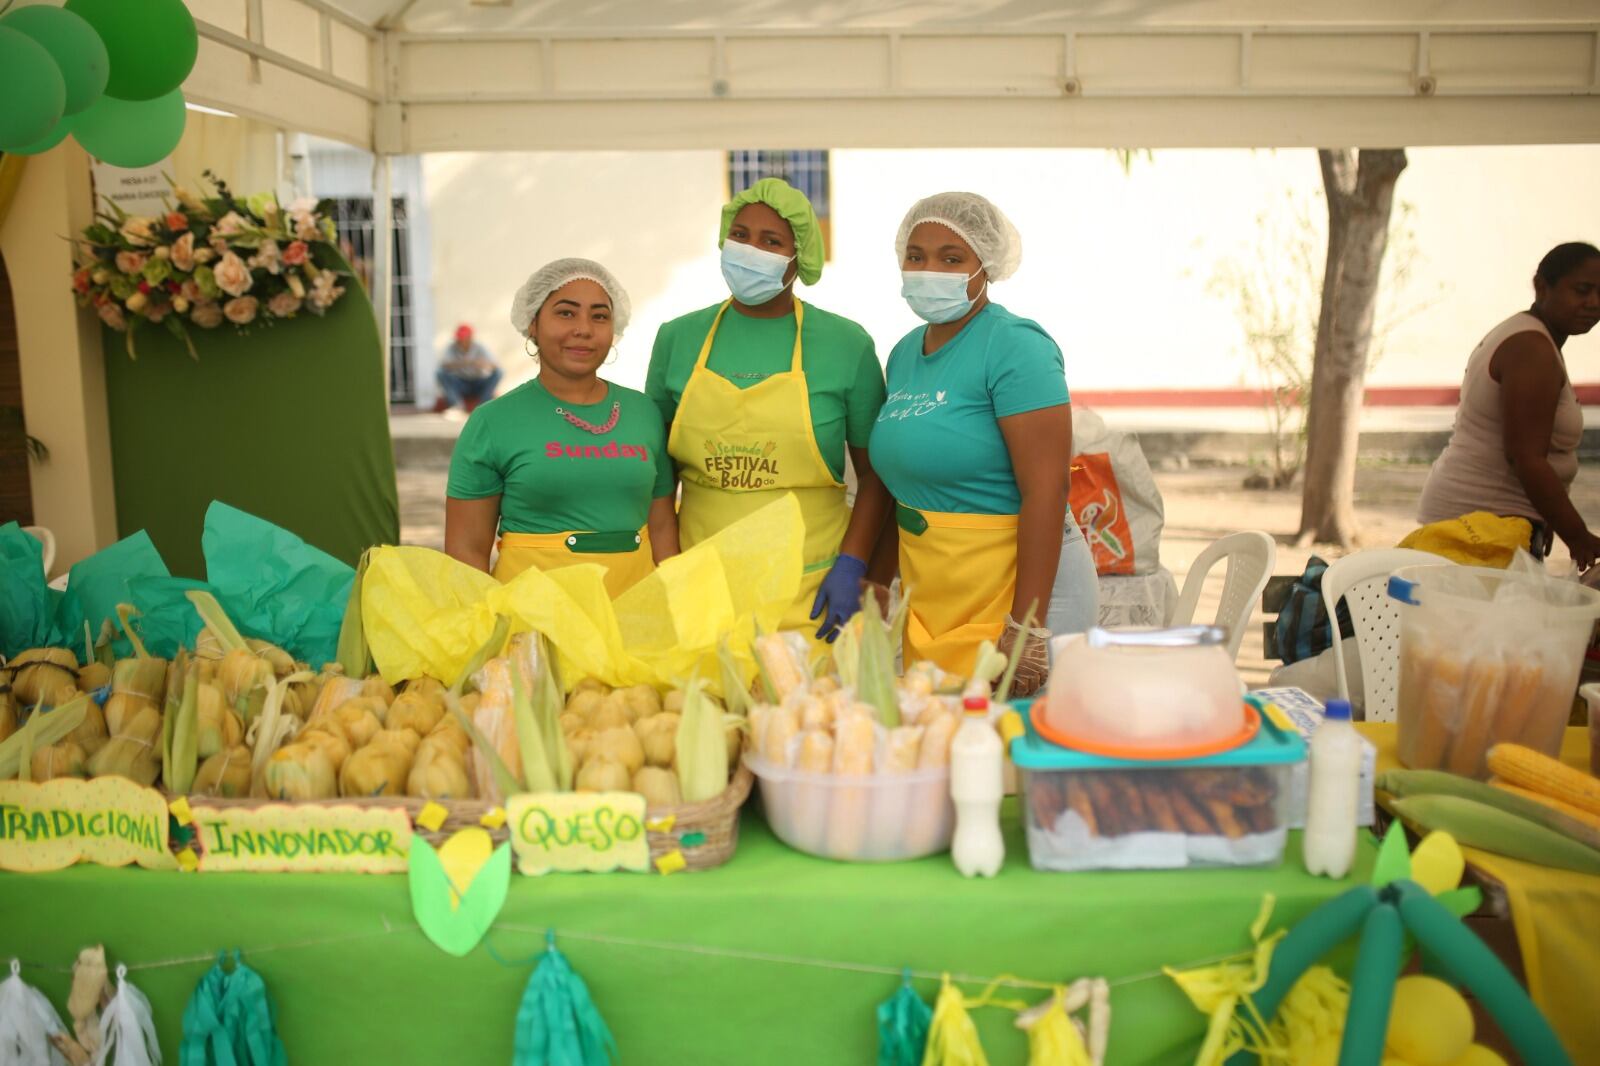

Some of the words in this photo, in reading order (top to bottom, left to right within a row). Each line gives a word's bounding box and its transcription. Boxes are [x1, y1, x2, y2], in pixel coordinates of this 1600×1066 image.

[545, 440, 648, 462] Sunday
[717, 441, 762, 458] Segundo
[704, 455, 780, 475] FESTIVAL
[721, 469, 763, 489] Bollo
[0, 803, 163, 854] TRADICIONAL
[519, 806, 641, 852] QUESO
[203, 821, 404, 859] INNOVADOR
